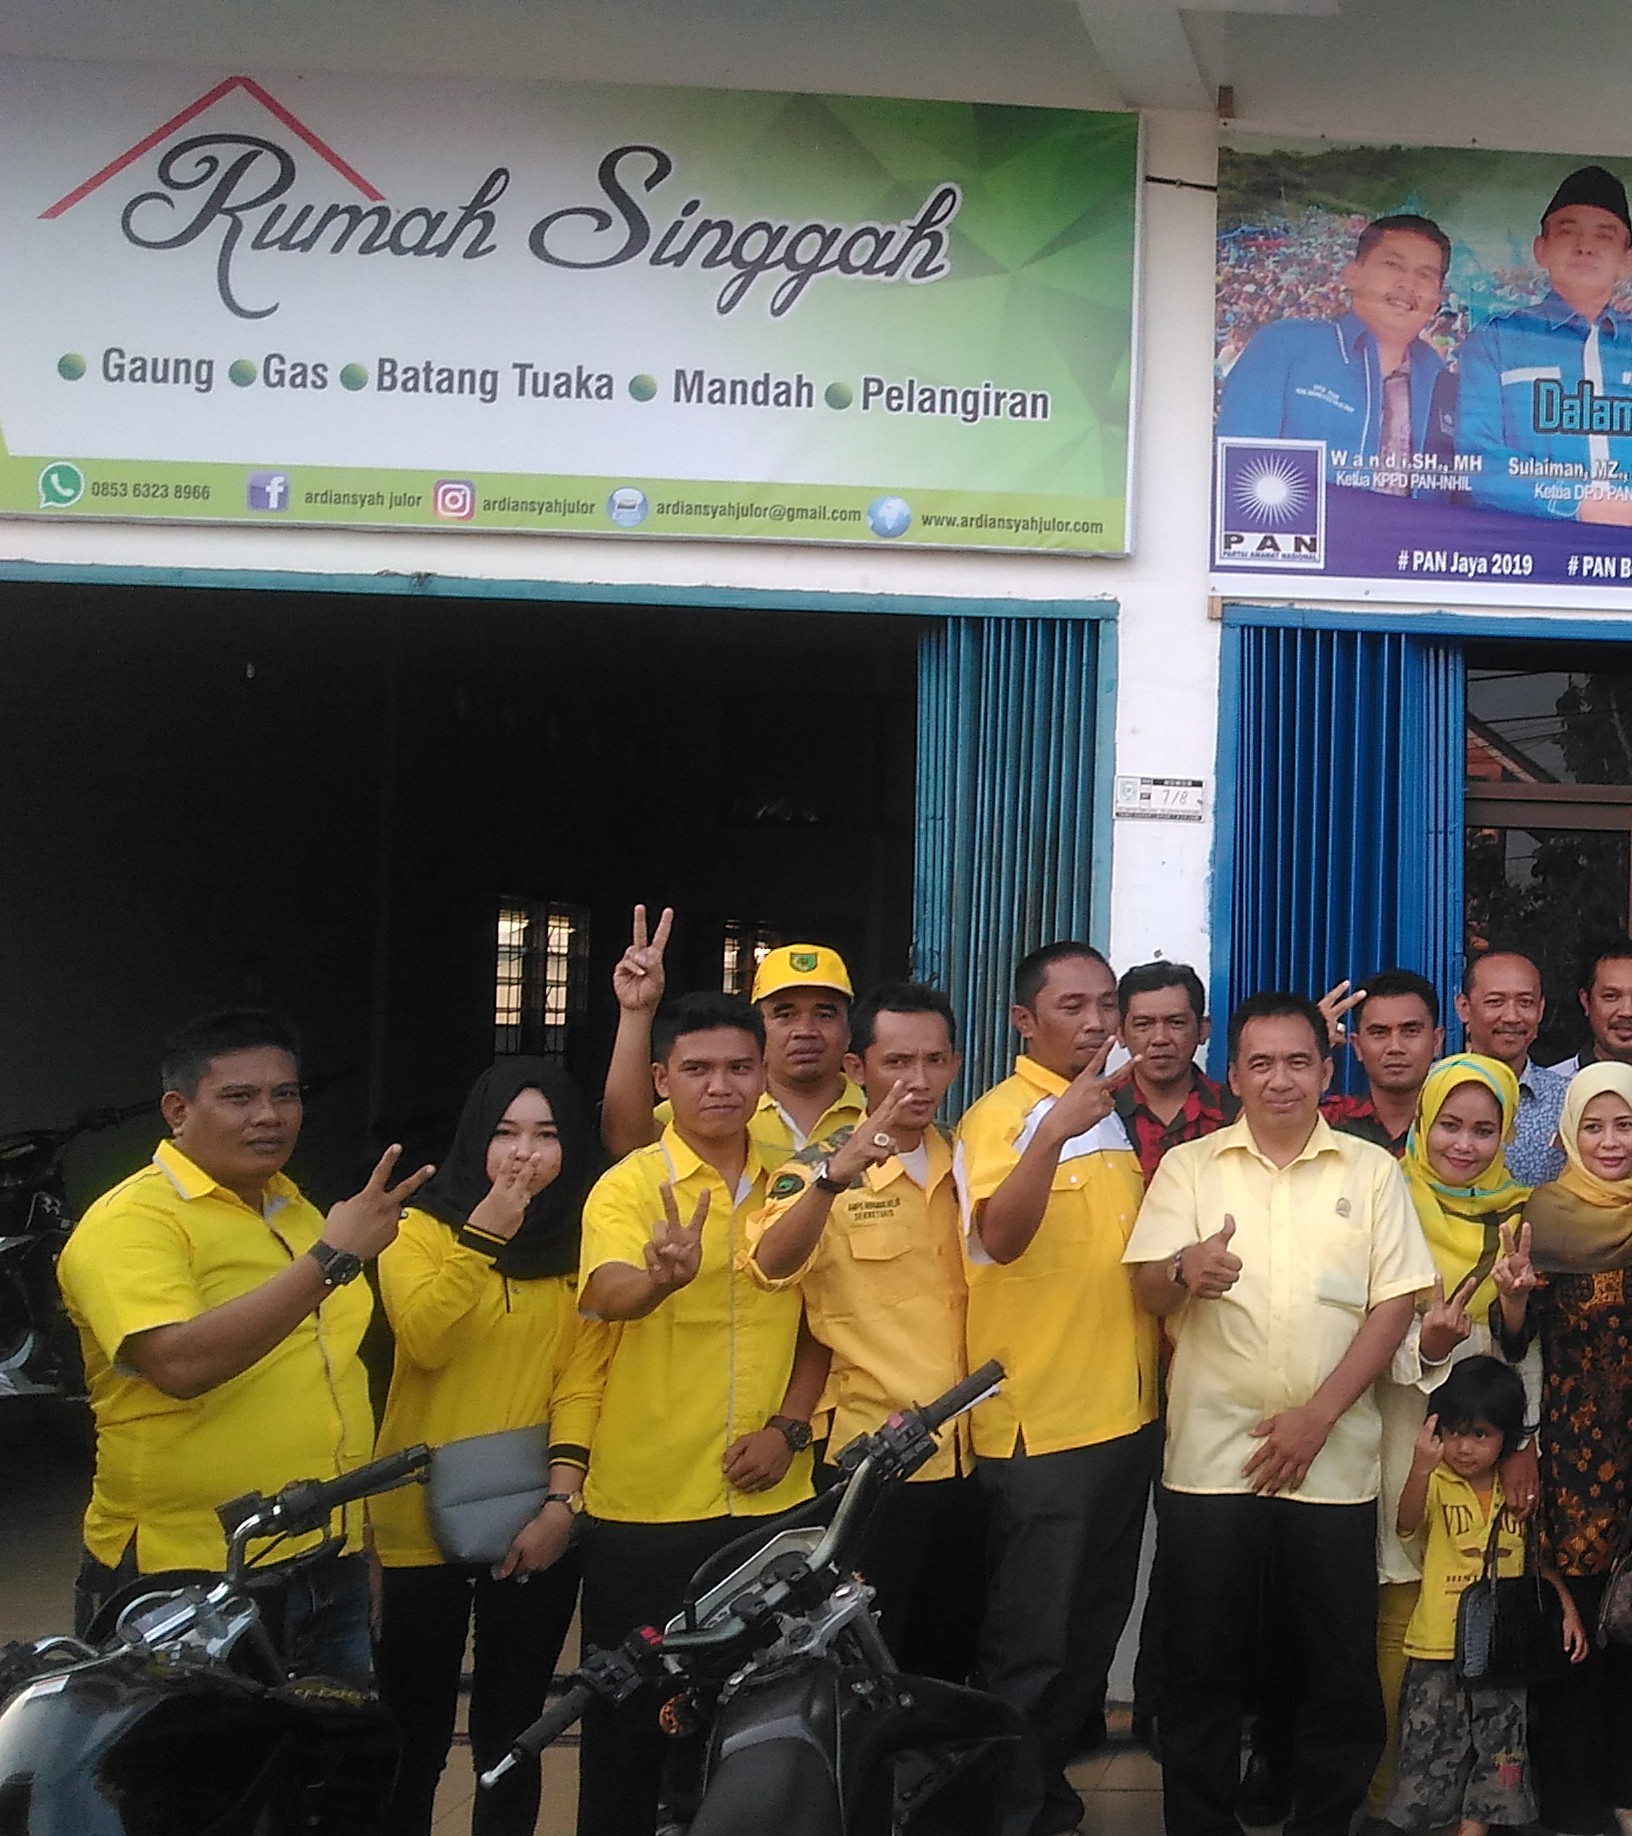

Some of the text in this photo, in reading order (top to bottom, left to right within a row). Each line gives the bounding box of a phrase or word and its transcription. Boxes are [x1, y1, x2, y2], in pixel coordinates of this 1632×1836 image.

[121, 133, 960, 319] Rumah Singgah
[102, 347, 1050, 424] Gaung Gas Batang Tuaka Mandah Pelangiran
[1453, 453, 1483, 472] MH
[1509, 456, 1588, 480] Sulaiman,
[91, 480, 211, 501] 0853 6323 8966
[1336, 471, 1472, 490] Ketua KPPD PAN-INHIL
[304, 488, 422, 510] ardiansyah julor
[1534, 484, 1571, 500] Ketua
[1574, 485, 1605, 501] DPD
[482, 496, 595, 516] ardiansyahjulor
[656, 499, 862, 523] ardiansyahjulor@gmail.com
[921, 512, 1104, 534] www.ardiansyahjulor.com
[1223, 534, 1317, 553] PAN
[1412, 551, 1447, 573] PAN
[1450, 553, 1487, 576] Jaya
[1492, 554, 1533, 576] 2019
[1582, 555, 1616, 578] PAN
